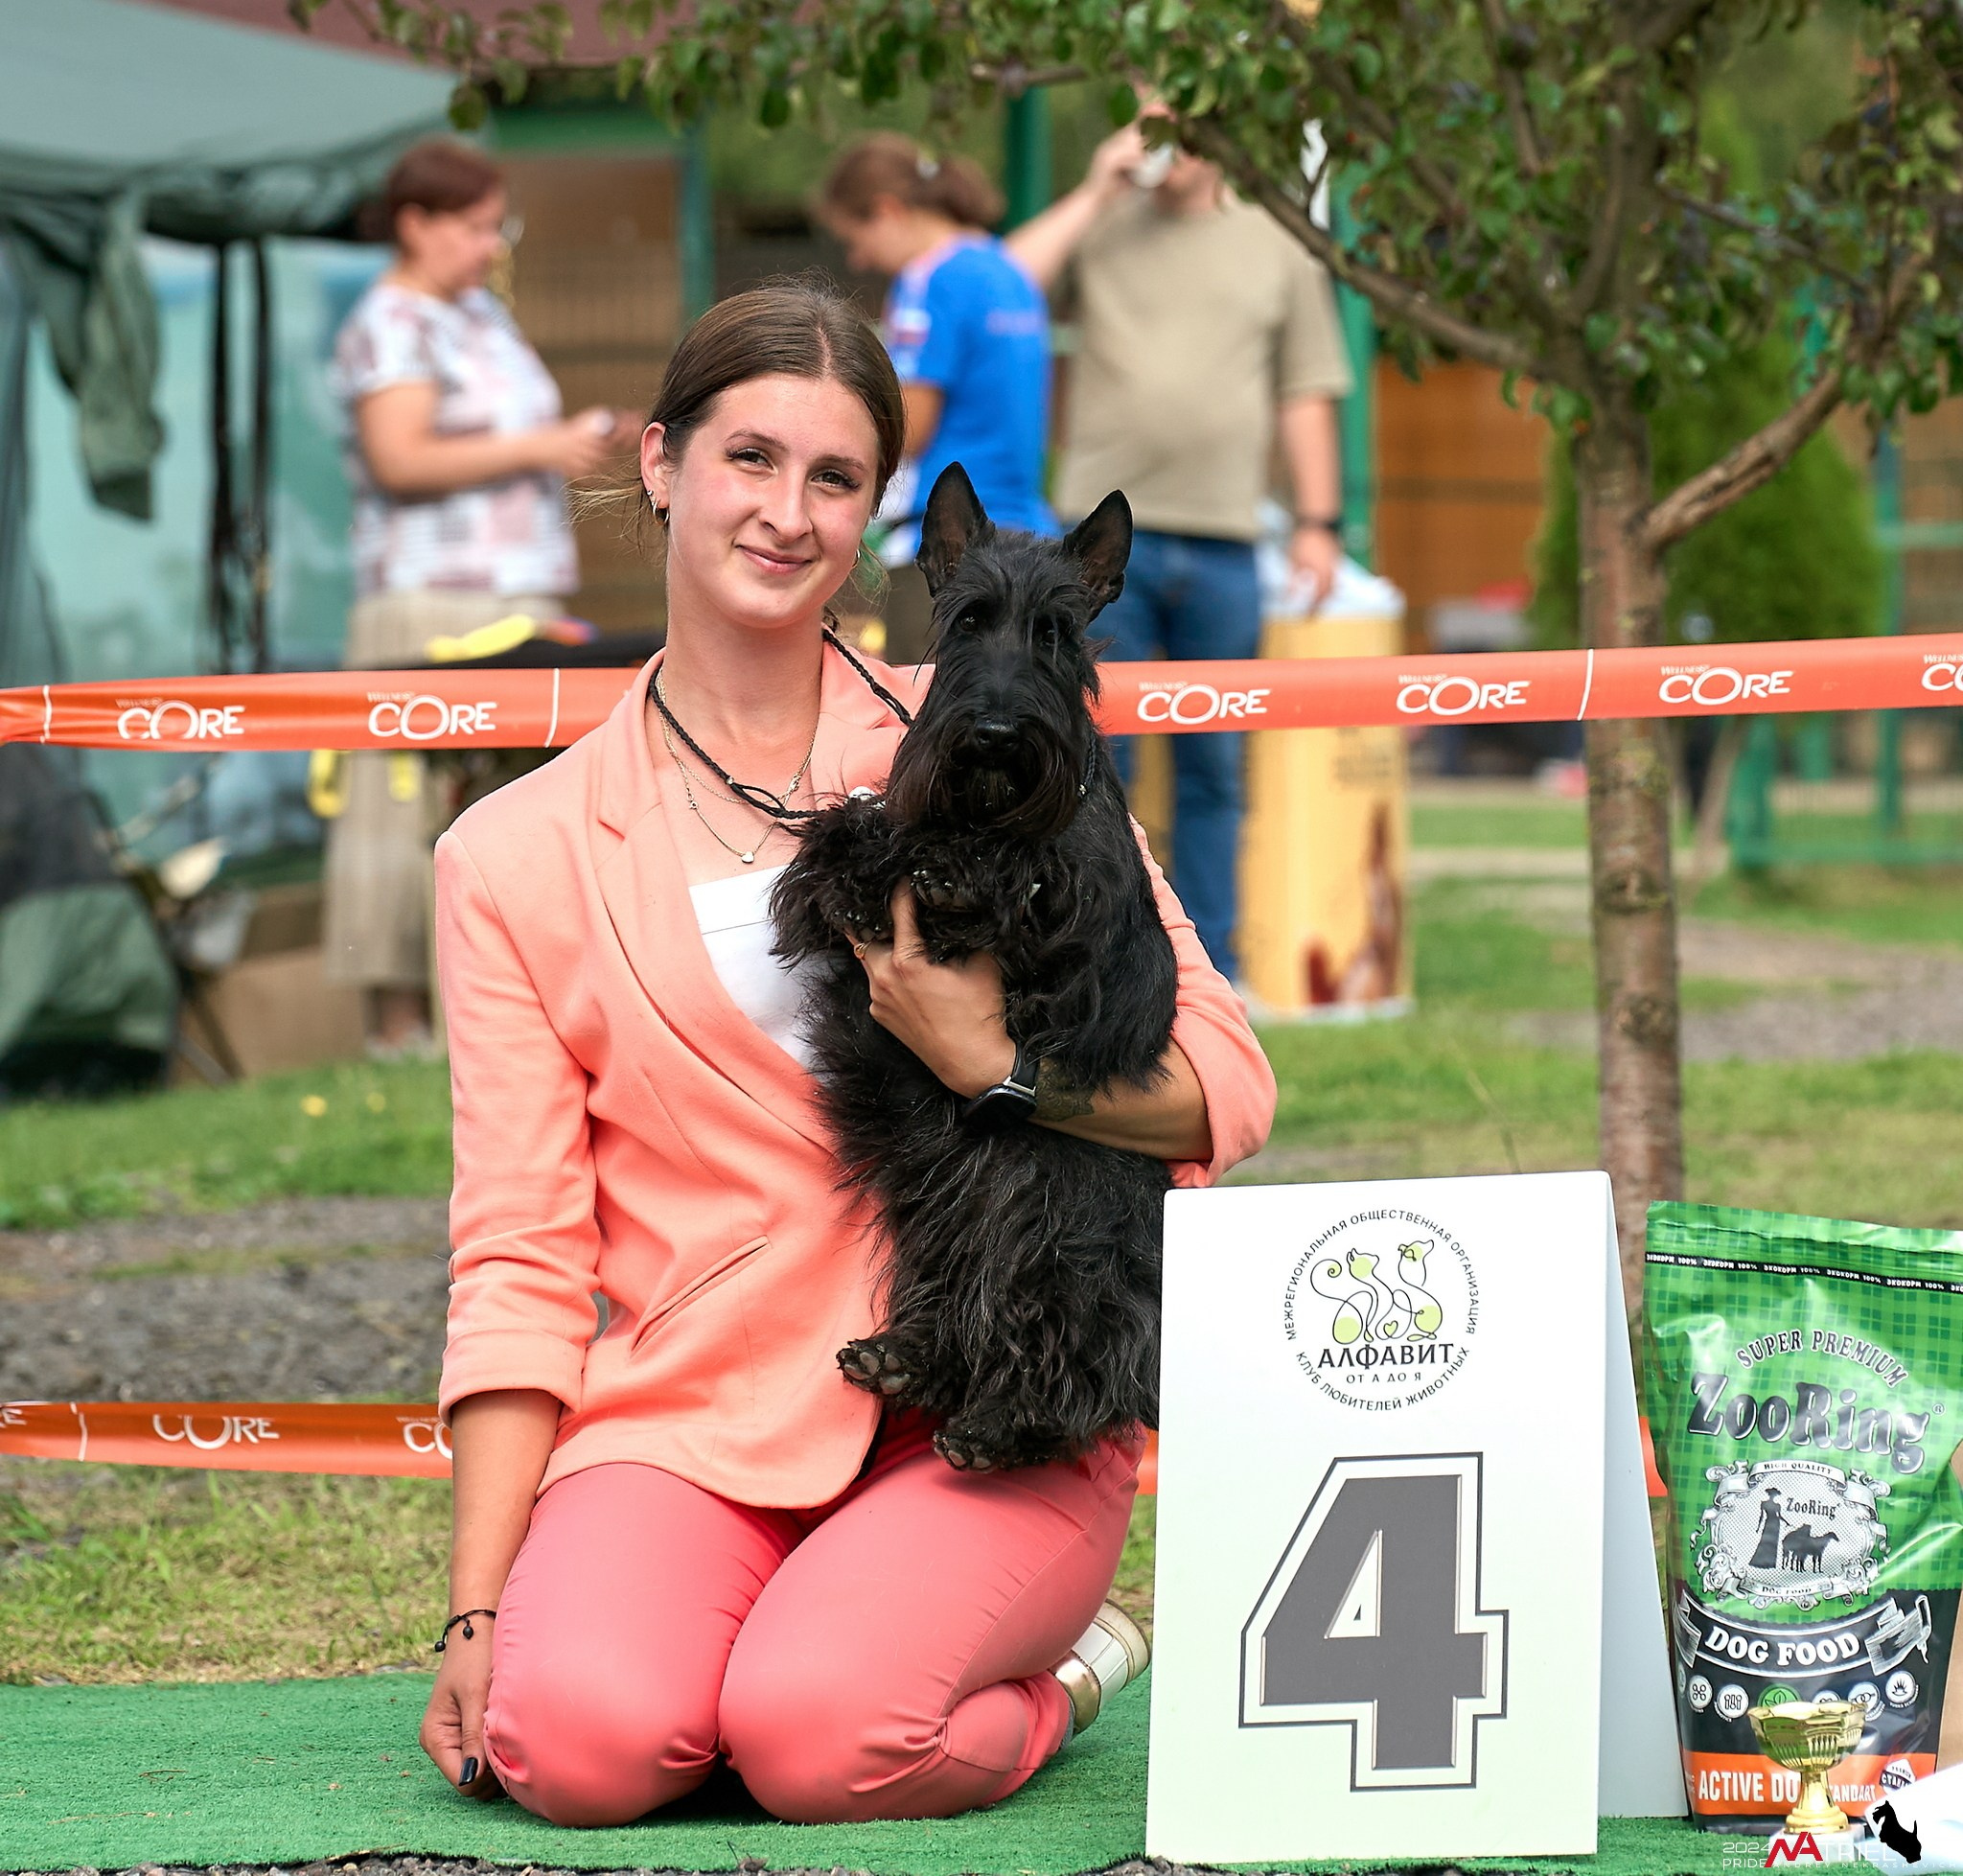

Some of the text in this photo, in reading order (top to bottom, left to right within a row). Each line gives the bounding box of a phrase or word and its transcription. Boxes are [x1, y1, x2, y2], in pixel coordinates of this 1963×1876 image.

[1397, 677, 1532, 715] CORE
[1658, 667, 1794, 706] CORE
[1921, 662, 1963, 691] C
[117, 700, 245, 739] CORE
[368, 694, 497, 740] CORE
[1137, 683, 1271, 725] CORE
[1283, 1209, 1480, 1341] МЕЖРЕГИОНАЛЬНАЯ ОБЩЕСТВЕННАЯ ОРГАНИЗАЦИЯ
[1677, 1257, 1697, 1265] 100%
[1764, 1264, 1797, 1274] ЭКОКОРМ
[1826, 1268, 1859, 1280] ЭКОКОРМ
[1862, 1275, 1882, 1284] 100%
[1886, 1278, 1922, 1288] ЭКОКОРМ
[1925, 1282, 1945, 1290] 100%
[1317, 1343, 1454, 1370] АЛФАВИТ
[1736, 1329, 1910, 1388] SUPER PREMIUM
[1296, 1346, 1470, 1412] КЛУБ ЛЮБИТЕЛЕЙ ЖИВОТНЫХ
[1346, 1372, 1421, 1384] ОТ А ДО Я
[1790, 1462, 1834, 1474] QUALITY
[1238, 1451, 1509, 1792] 4
[1704, 1626, 1860, 1666] DOG FOOD
[1698, 1770, 1765, 1802] ACTIVE
[1771, 1772, 1801, 1803] DO
